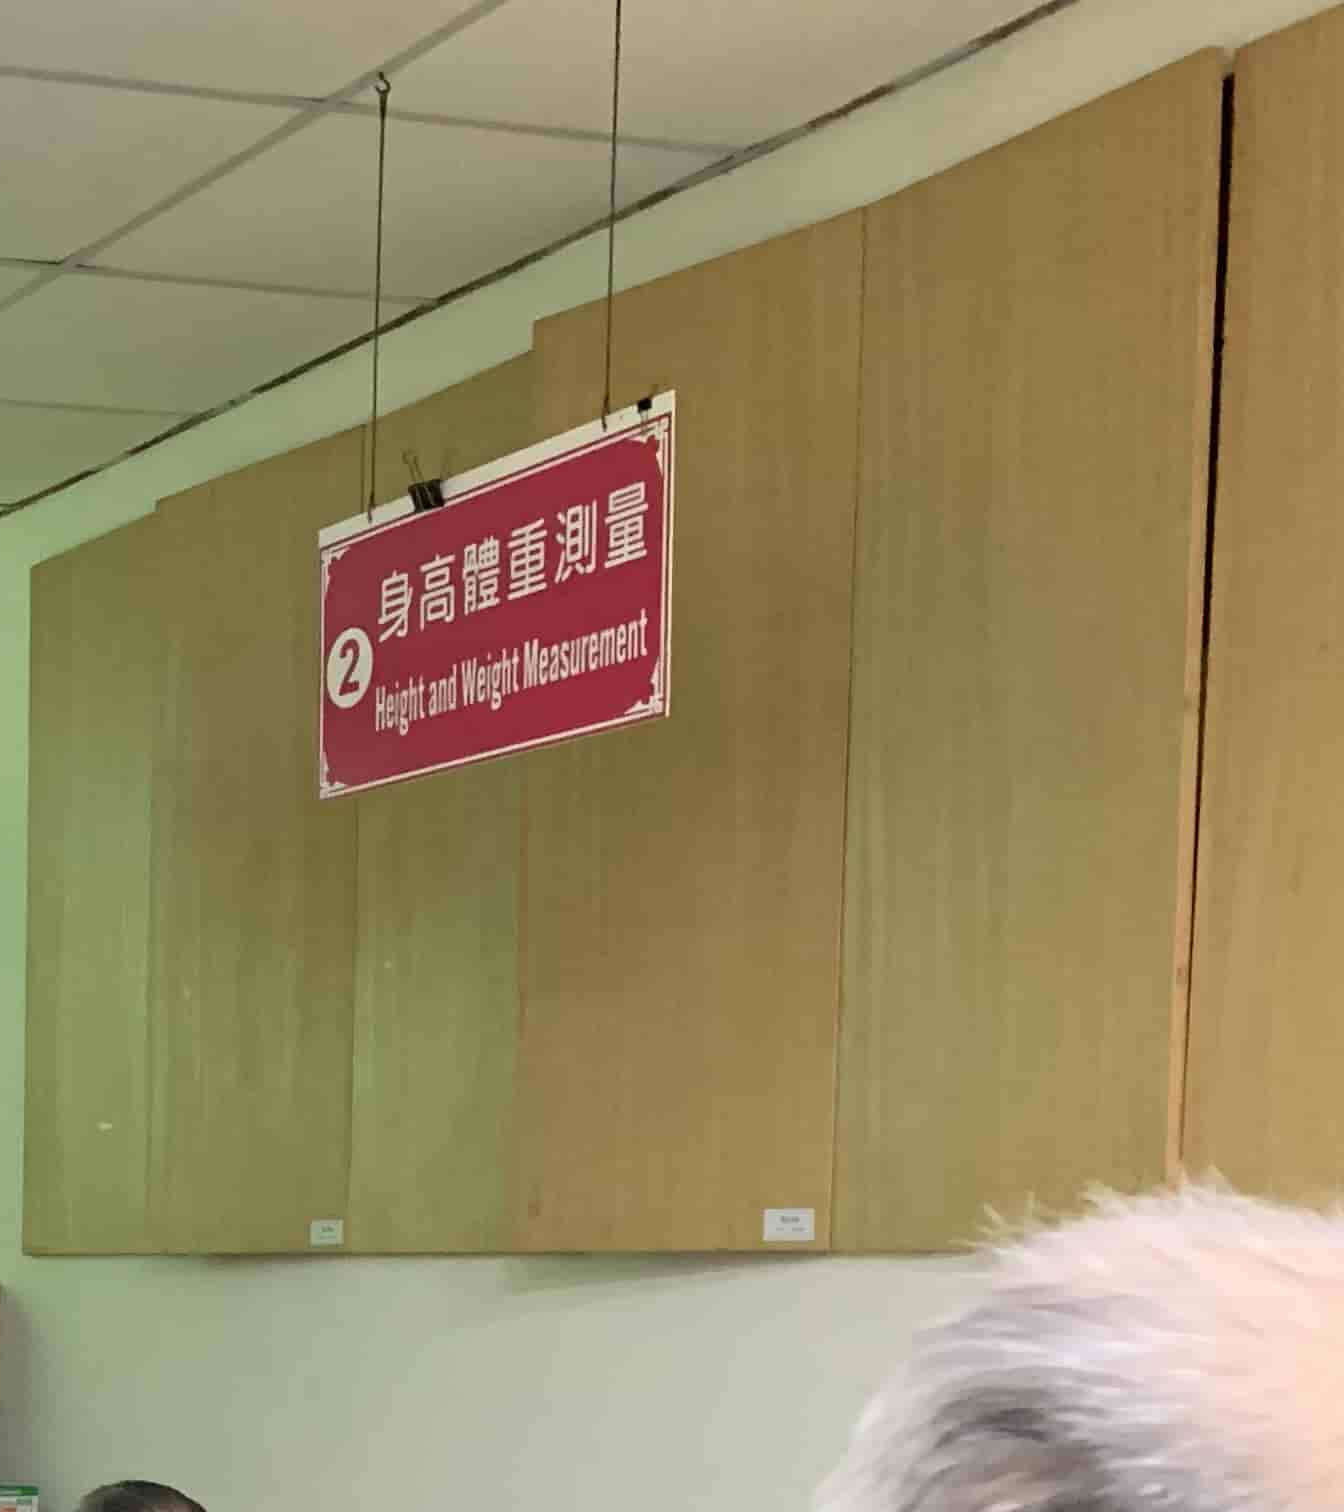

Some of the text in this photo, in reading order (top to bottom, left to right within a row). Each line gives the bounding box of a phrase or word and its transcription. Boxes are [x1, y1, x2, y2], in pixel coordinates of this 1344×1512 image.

[378, 481, 648, 643] 身高體重測量
[375, 608, 649, 736] Height and Weight Measurement
